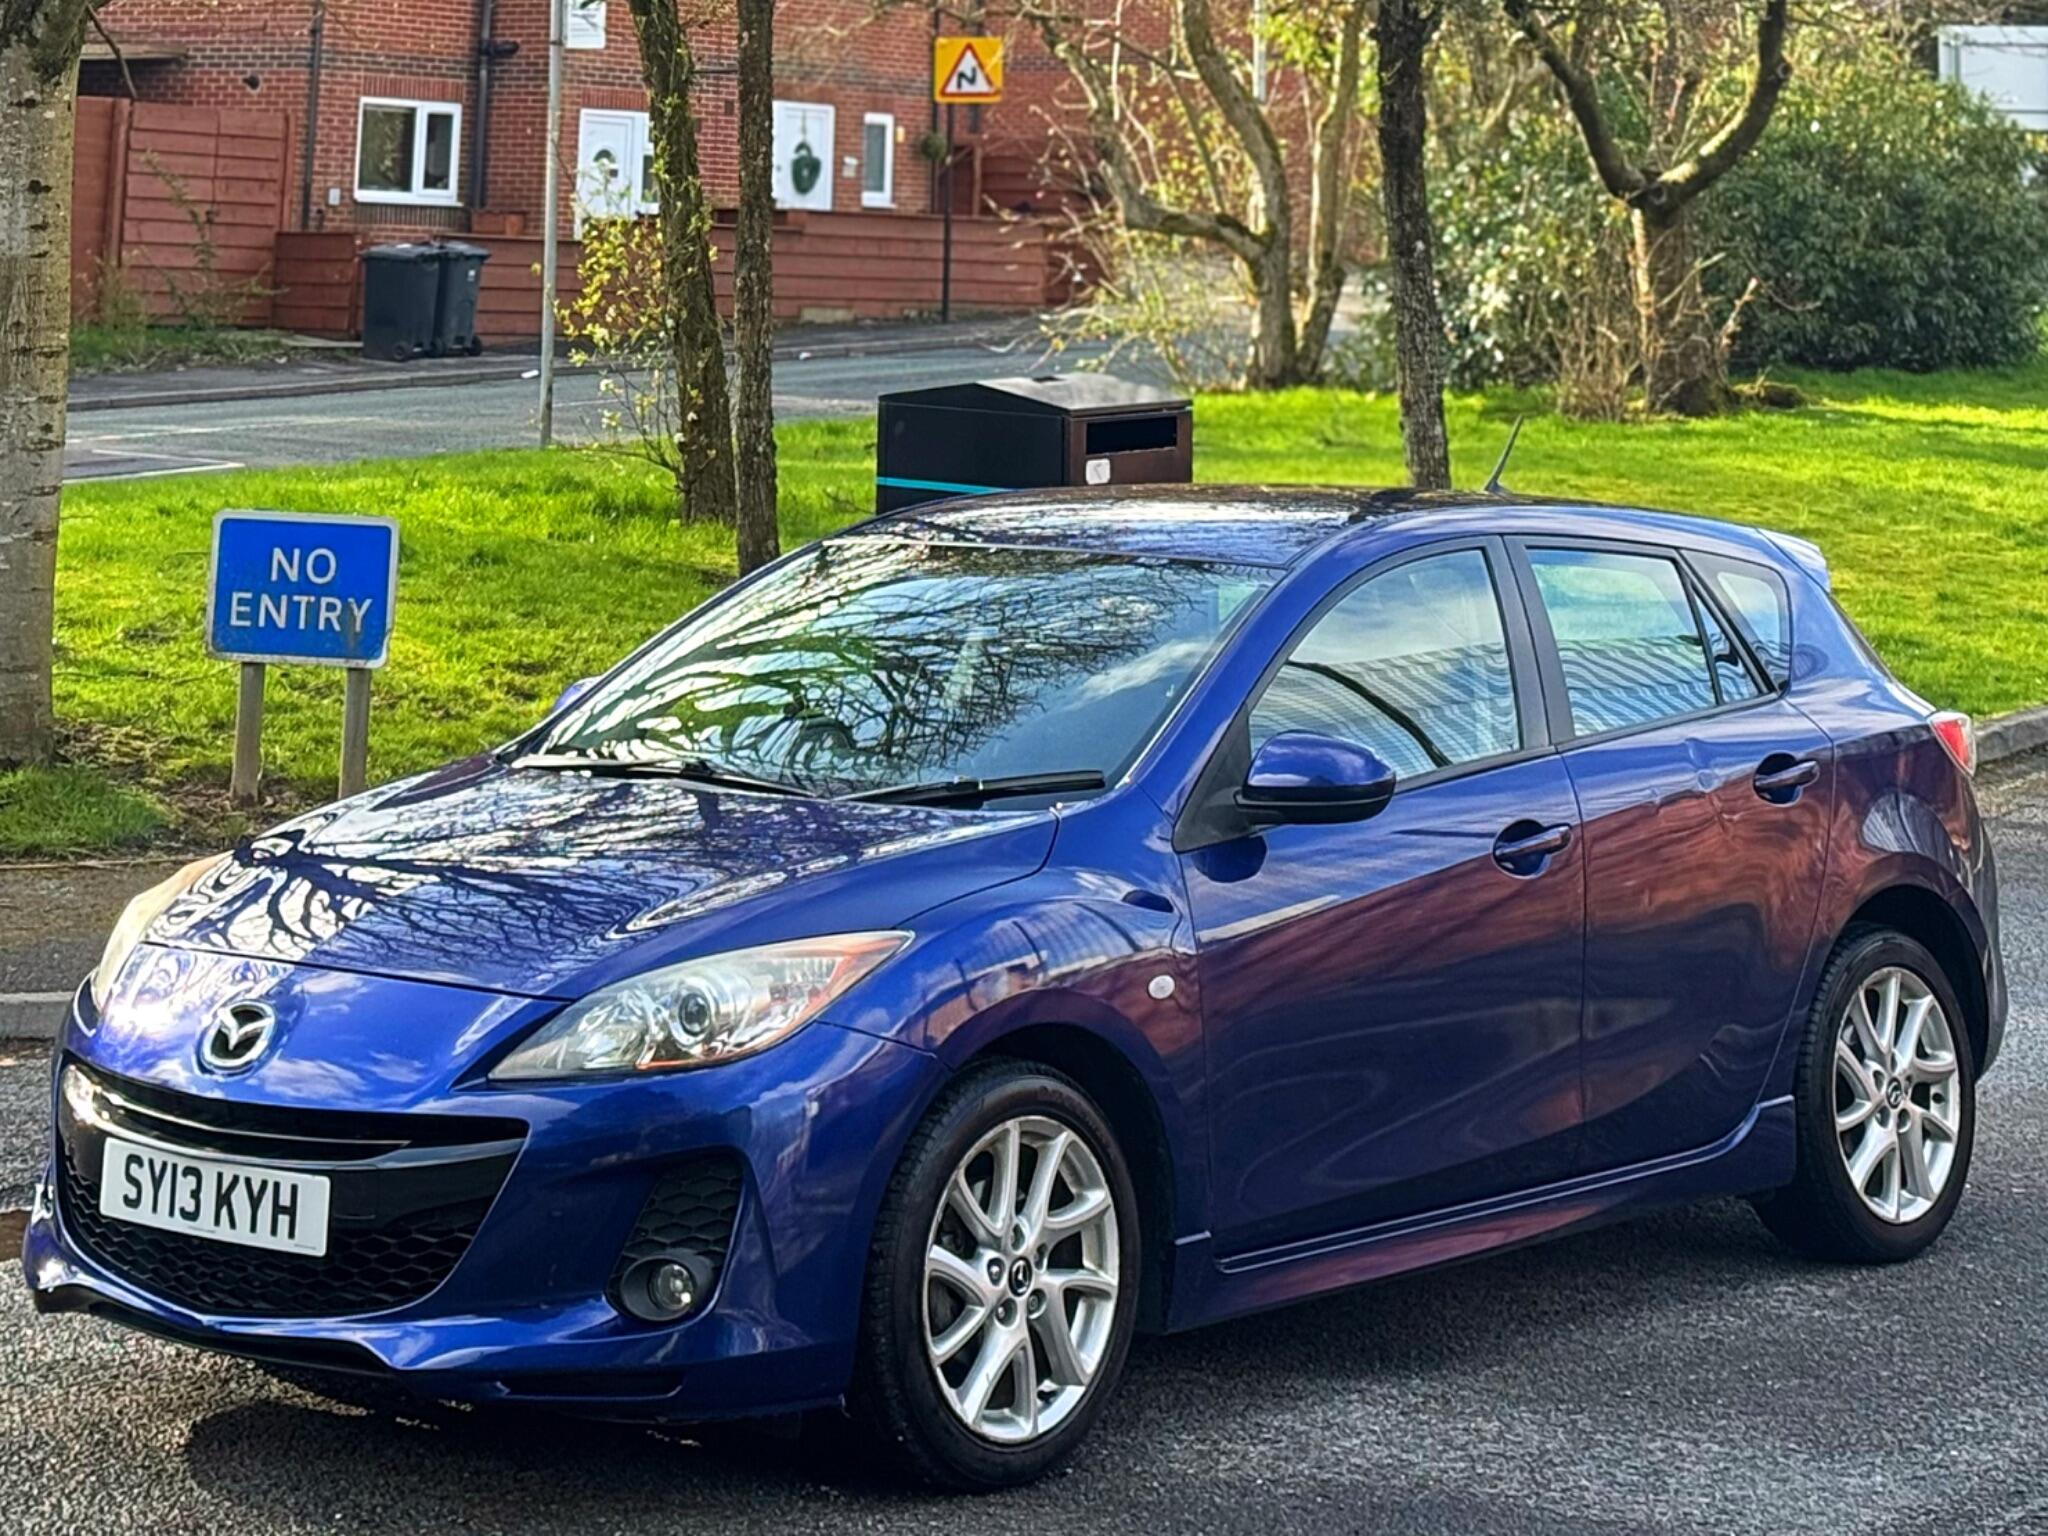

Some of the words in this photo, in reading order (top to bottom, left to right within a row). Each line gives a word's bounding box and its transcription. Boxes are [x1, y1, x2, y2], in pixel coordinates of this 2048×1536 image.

[270, 547, 337, 584] NO
[230, 591, 373, 633] ENTRY
[122, 1153, 203, 1223] SY13
[213, 1170, 299, 1240] KYH
